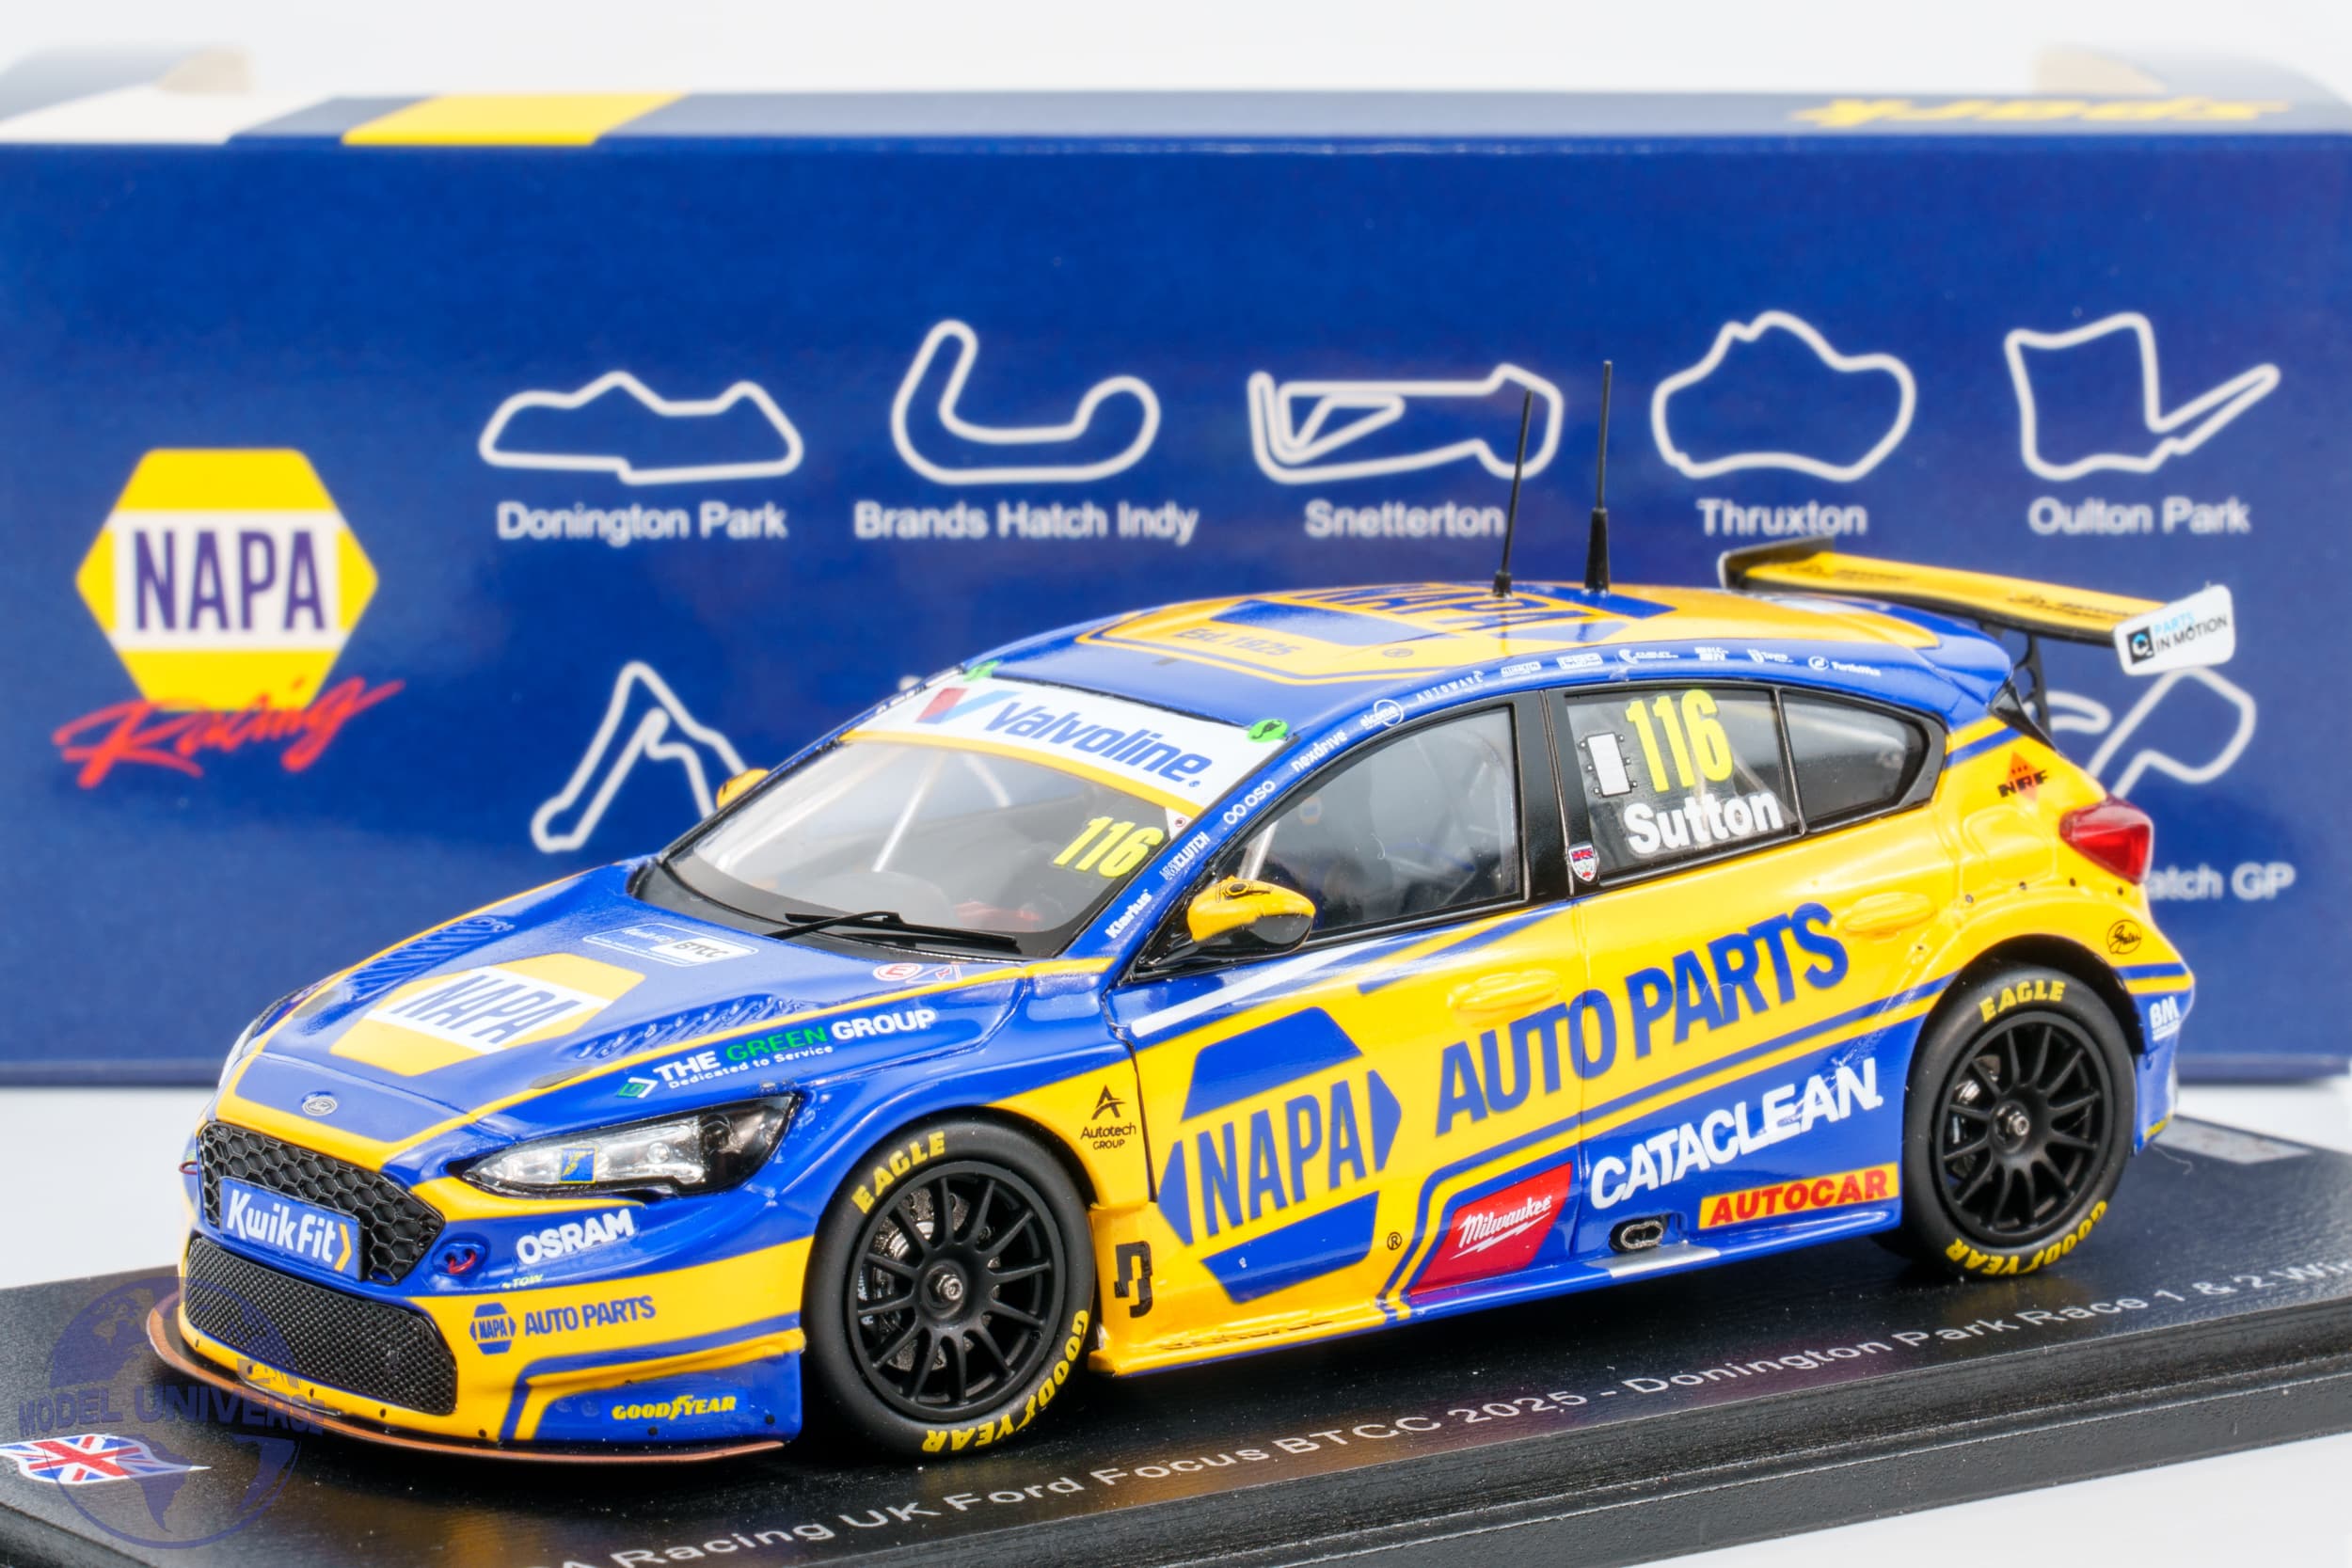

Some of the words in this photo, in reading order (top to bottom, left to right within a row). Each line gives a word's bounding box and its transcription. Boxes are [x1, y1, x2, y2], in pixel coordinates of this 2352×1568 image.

[497, 500, 690, 547] Donington
[699, 500, 788, 540] Park
[853, 501, 988, 540] Brands
[997, 501, 1108, 540] Hatch
[1117, 501, 1199, 546] Indy
[1304, 500, 1506, 539] Snetterton
[1696, 499, 1867, 536] Thruxton
[2027, 497, 2151, 534] Oulton
[2163, 497, 2250, 534] Park
[134, 530, 326, 631] NAPA
[2153, 611, 2196, 634] PARTS
[2156, 636, 2170, 652] IN
[2173, 613, 2228, 644] MOTION
[983, 701, 1213, 784] Valvoline
[1625, 689, 1733, 792] 116
[1997, 769, 2048, 798] NRF
[1624, 792, 1784, 854] Sutton
[1053, 816, 1164, 879] 116
[2231, 863, 2296, 901] GP
[675, 942, 729, 958] BTCC
[388, 974, 584, 1045] NAPA
[1436, 989, 1617, 1138] AUTO
[1626, 902, 1850, 1061] PARTS
[1979, 980, 2065, 1022] EAGLE
[653, 1051, 721, 1082] THE
[725, 1025, 828, 1063] GREEN
[831, 1008, 937, 1040] GROUP
[668, 1061, 749, 1089] Dedicated
[753, 1054, 770, 1069] to
[775, 1044, 834, 1064] Service
[1080, 1122, 1136, 1140] Autotech
[1092, 1138, 1125, 1150] GROUP
[1590, 1058, 1883, 1210] CATACLEAN
[851, 1132, 946, 1214] EAGLE
[1197, 1080, 1367, 1237] NAPA
[1459, 1194, 1552, 1248] Milwaukee
[1708, 1168, 1888, 1227] AUTOCAR
[516, 1209, 636, 1265] OSRAM
[514, 1274, 544, 1288] TOW
[479, 1318, 508, 1339] NAPA
[524, 1306, 580, 1337] AUTO
[581, 1295, 657, 1328] PARTS
[922, 1309, 1089, 1452] GOODYEAR
[610, 1522, 835, 1568] Racing
[839, 1500, 940, 1528] UK
[943, 1477, 1085, 1511] Ford
[1090, 1447, 1269, 1486] Focus
[1271, 1415, 1441, 1455] BTCC
[1448, 1390, 1587, 1424] 2025
[1621, 1338, 1893, 1395] Donington
[1891, 1317, 2021, 1347] Park
[2015, 1294, 2150, 1326] Race
[2154, 1289, 2186, 1303] 1
[2192, 1281, 2238, 1295] &
[2233, 1275, 2277, 1289] 2
[612, 1394, 738, 1421] GOODYEAR
